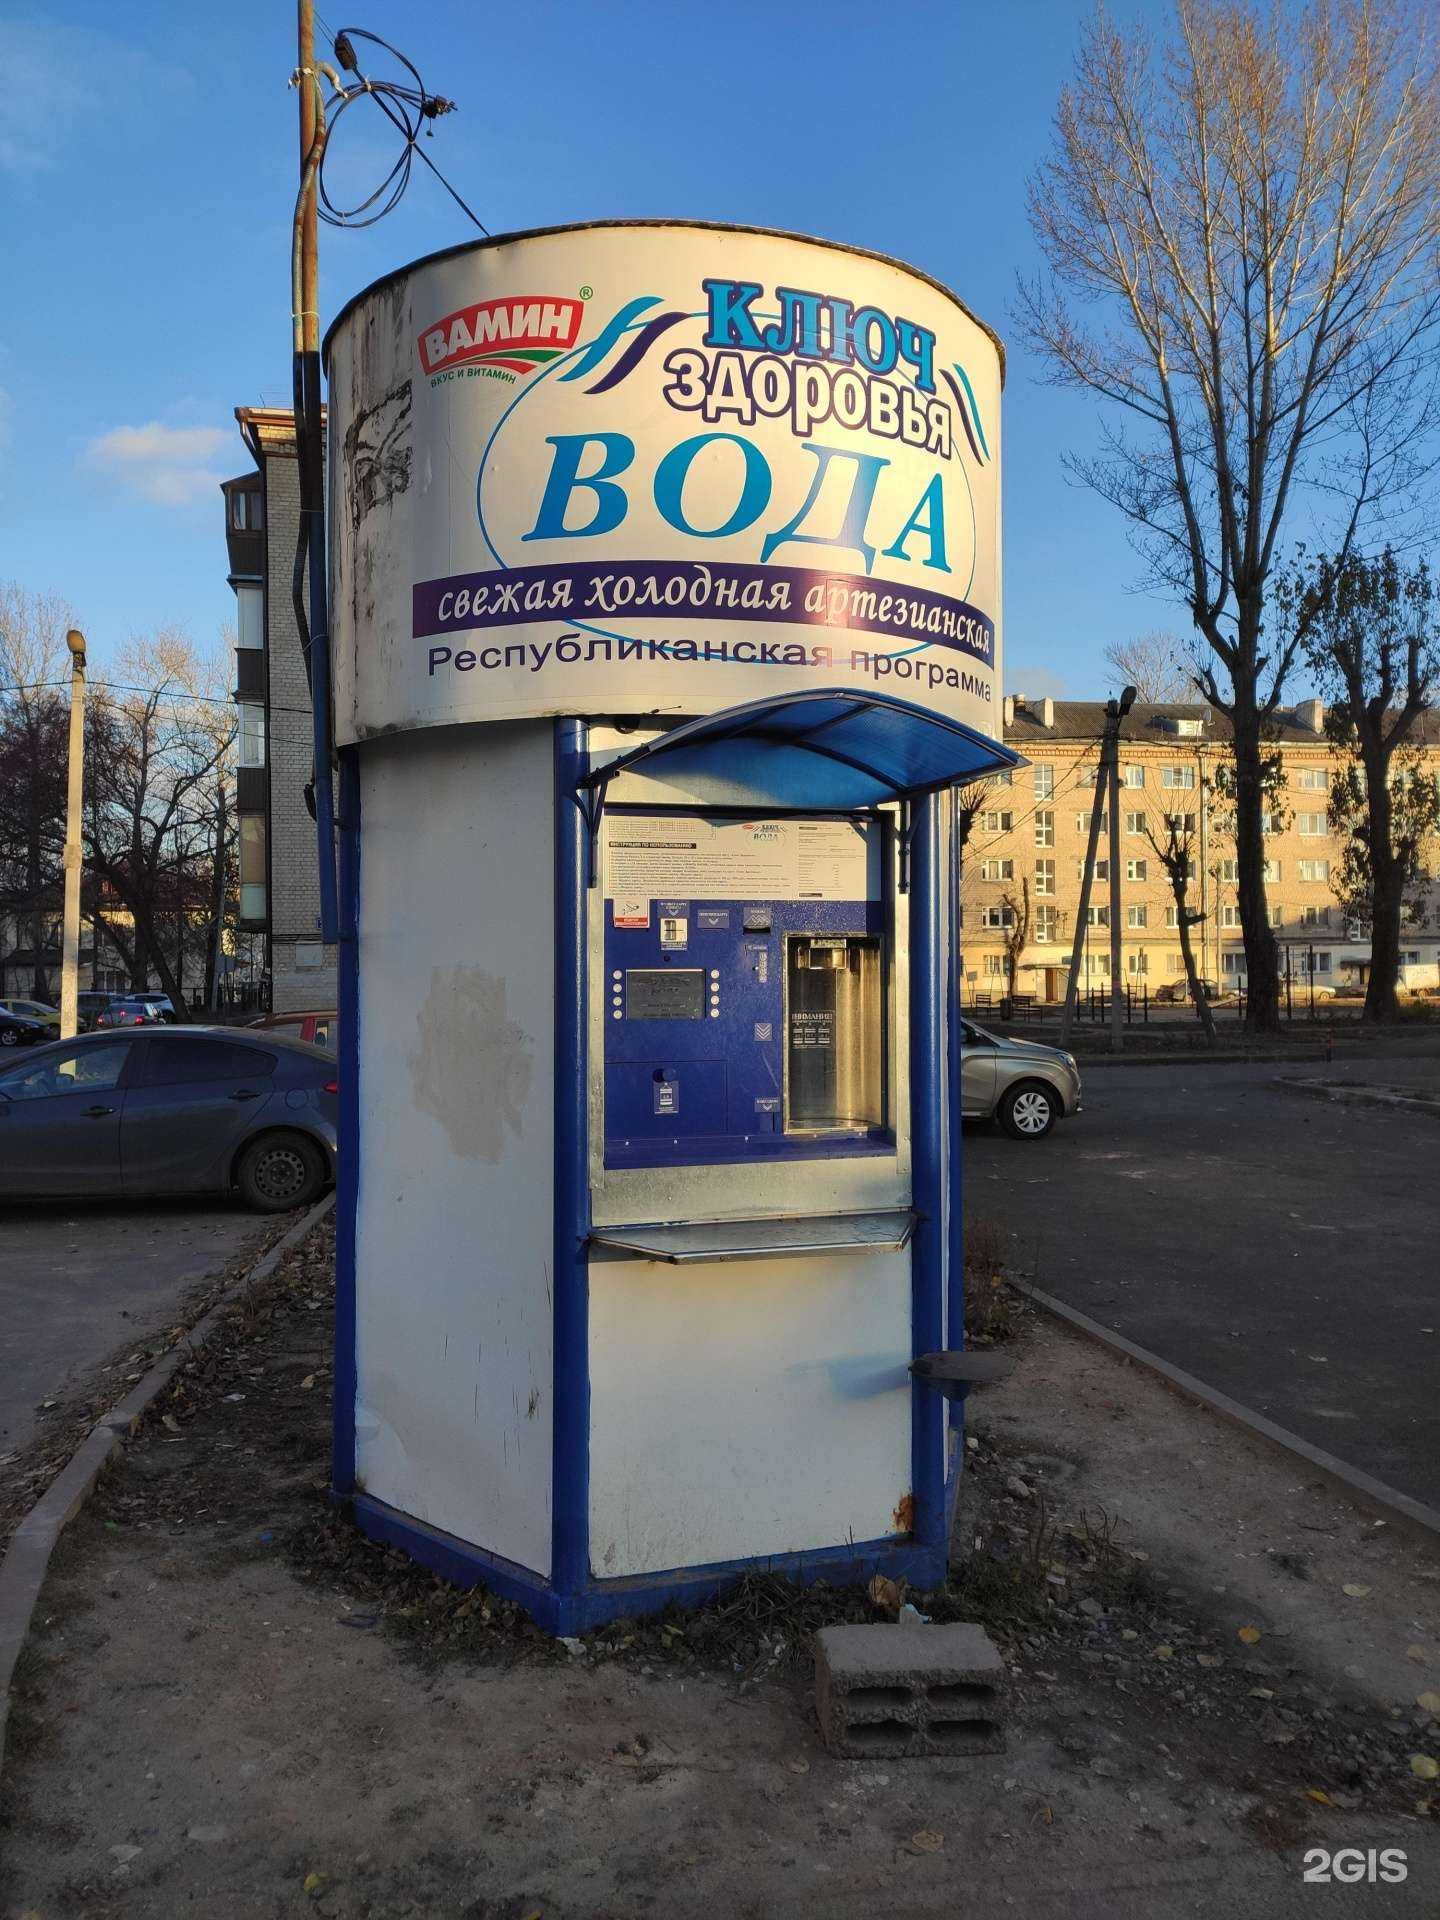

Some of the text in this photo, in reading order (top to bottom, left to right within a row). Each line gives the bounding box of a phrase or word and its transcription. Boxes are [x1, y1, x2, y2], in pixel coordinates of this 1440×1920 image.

[424, 303, 574, 367] ВАМИН
[702, 278, 936, 395] КЛЮЧ
[430, 368, 518, 389] ВКУС И ВИТАМИН
[520, 432, 953, 576] ВОДА
[437, 564, 991, 654] свежая холодная артезианская
[428, 632, 992, 703] Республиканская программа
